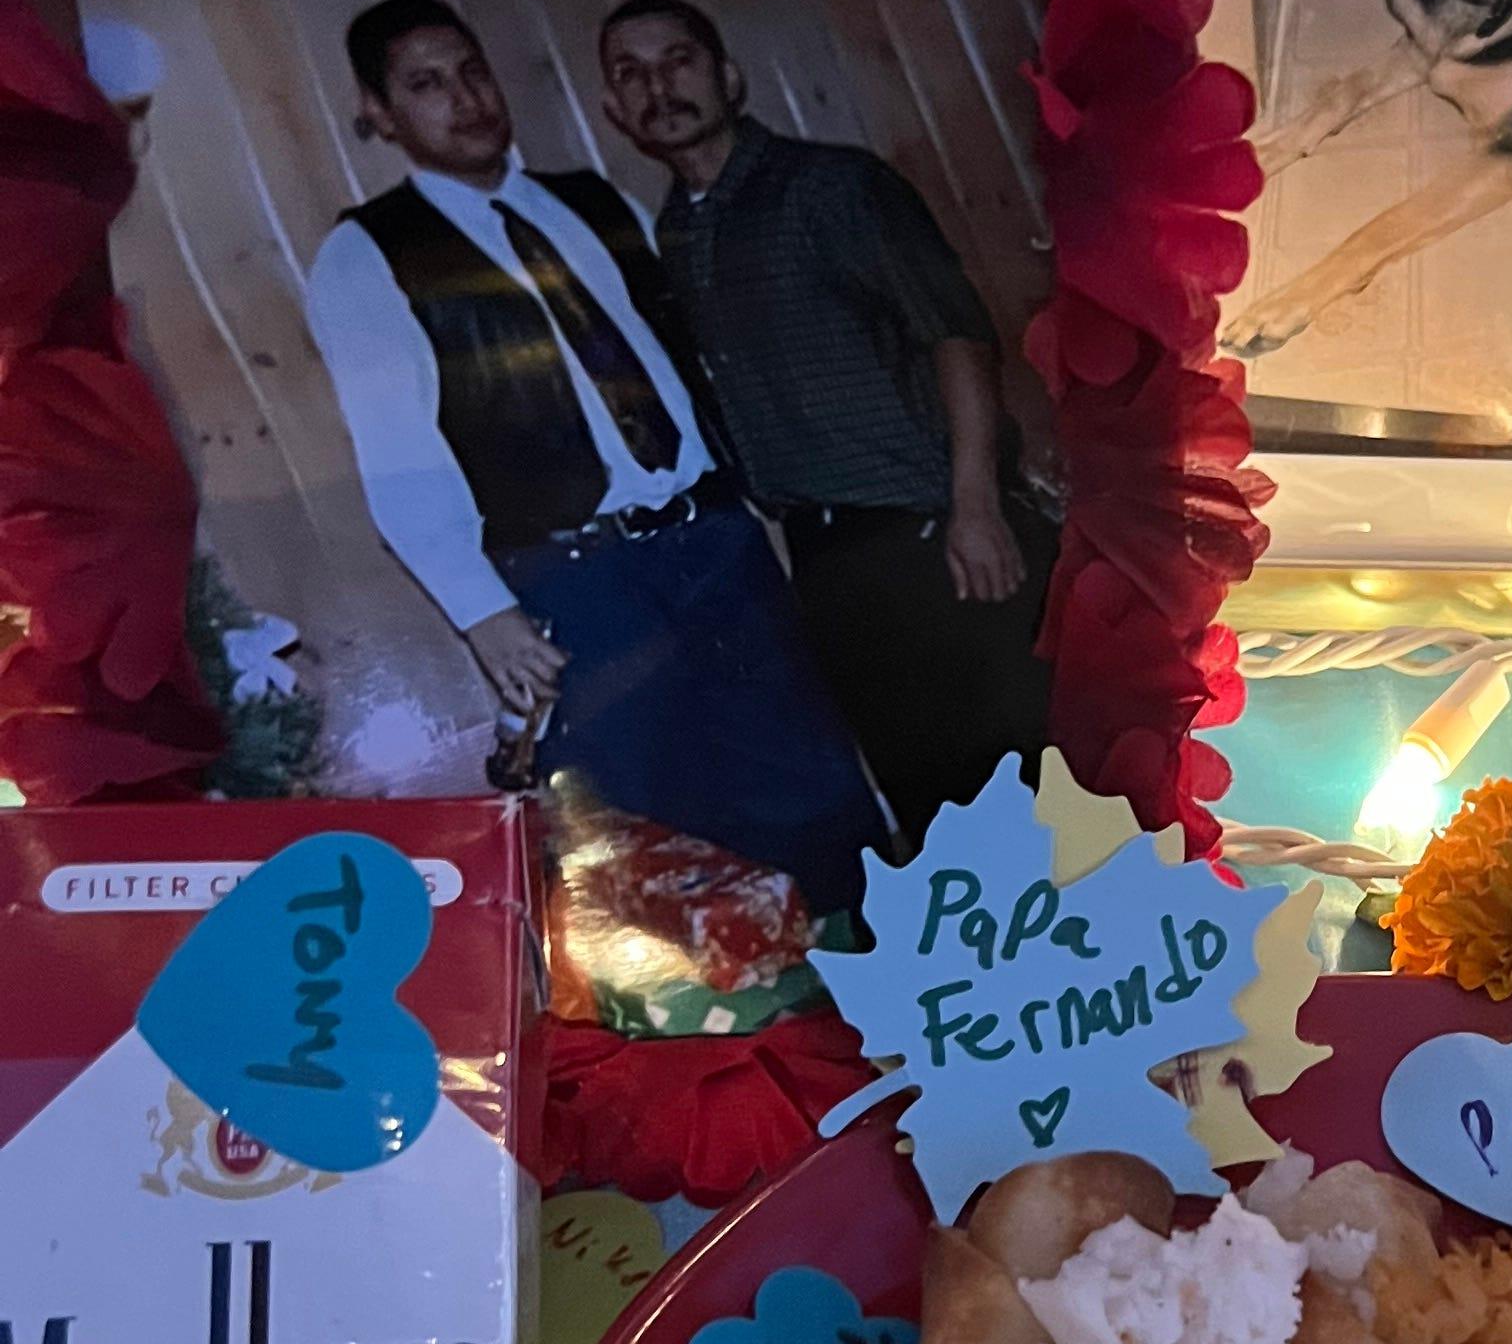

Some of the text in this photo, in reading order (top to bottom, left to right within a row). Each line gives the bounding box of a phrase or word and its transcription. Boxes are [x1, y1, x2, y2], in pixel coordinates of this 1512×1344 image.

[65, 875, 190, 900] FILTER
[917, 913, 1228, 1067] Fernando
[227, 1144, 260, 1160] USA
